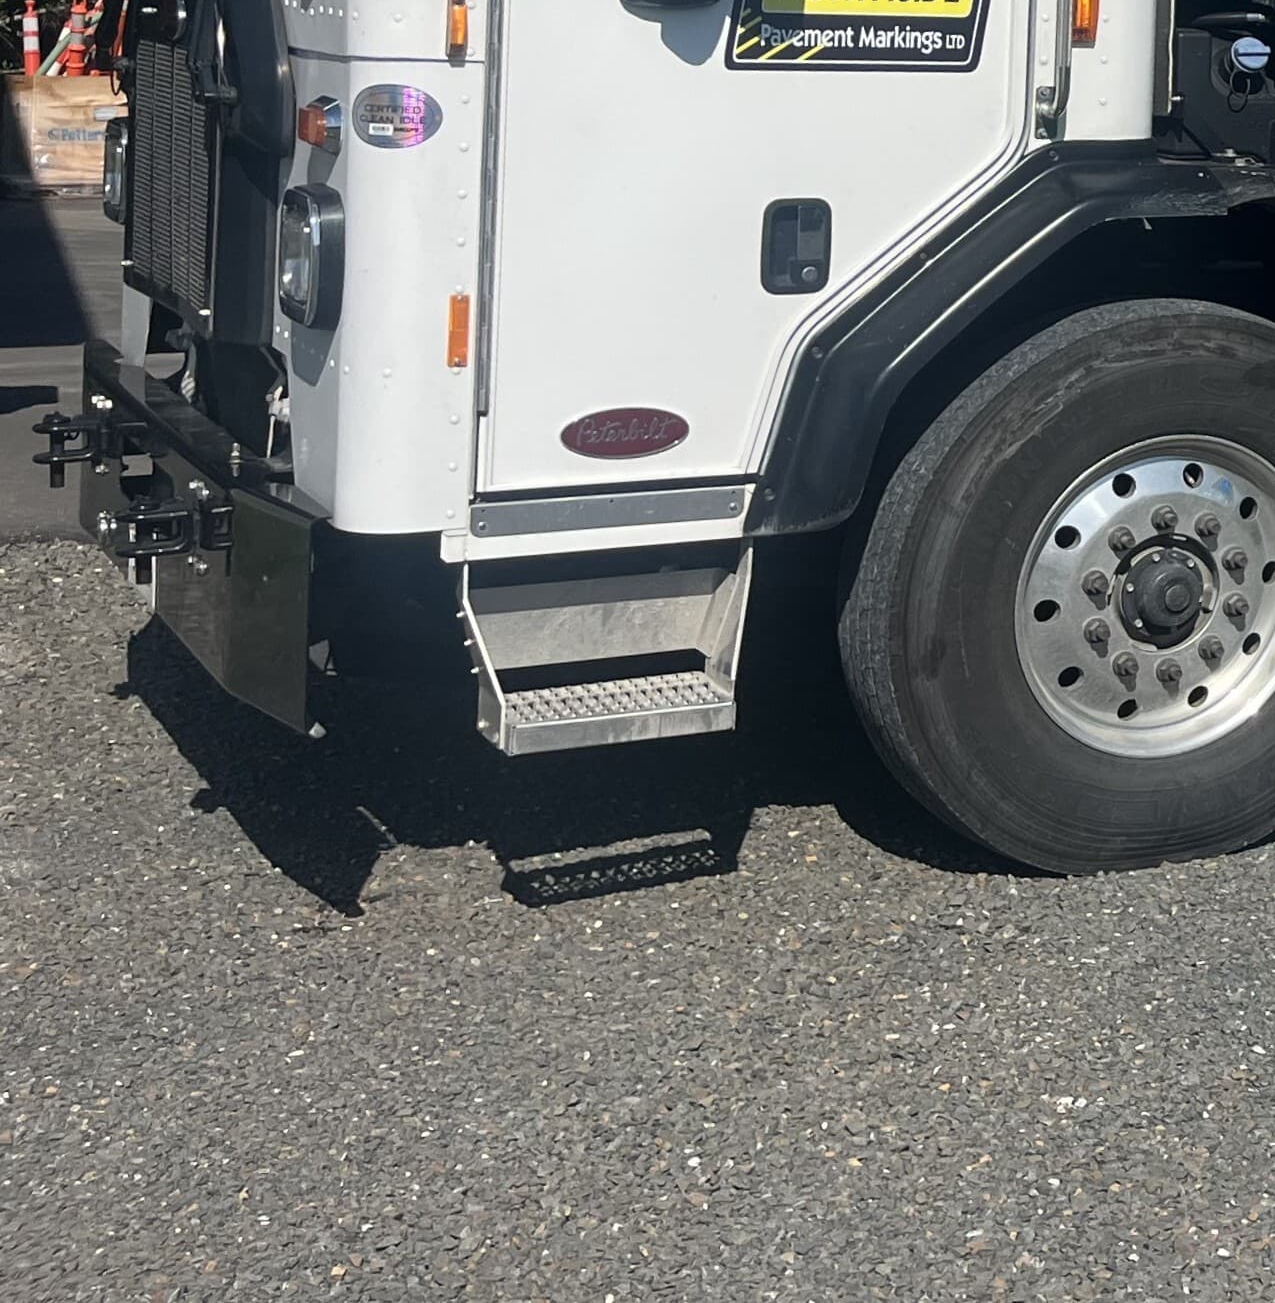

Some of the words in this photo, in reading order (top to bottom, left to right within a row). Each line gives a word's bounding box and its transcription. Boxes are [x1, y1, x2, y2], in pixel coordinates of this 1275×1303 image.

[760, 23, 854, 48] Pavement
[859, 25, 943, 55] Markings
[945, 33, 966, 49] LTD
[360, 113, 394, 124] CLEAN
[364, 104, 422, 115] CERTIFIED
[576, 416, 679, 447] Peterbilt
